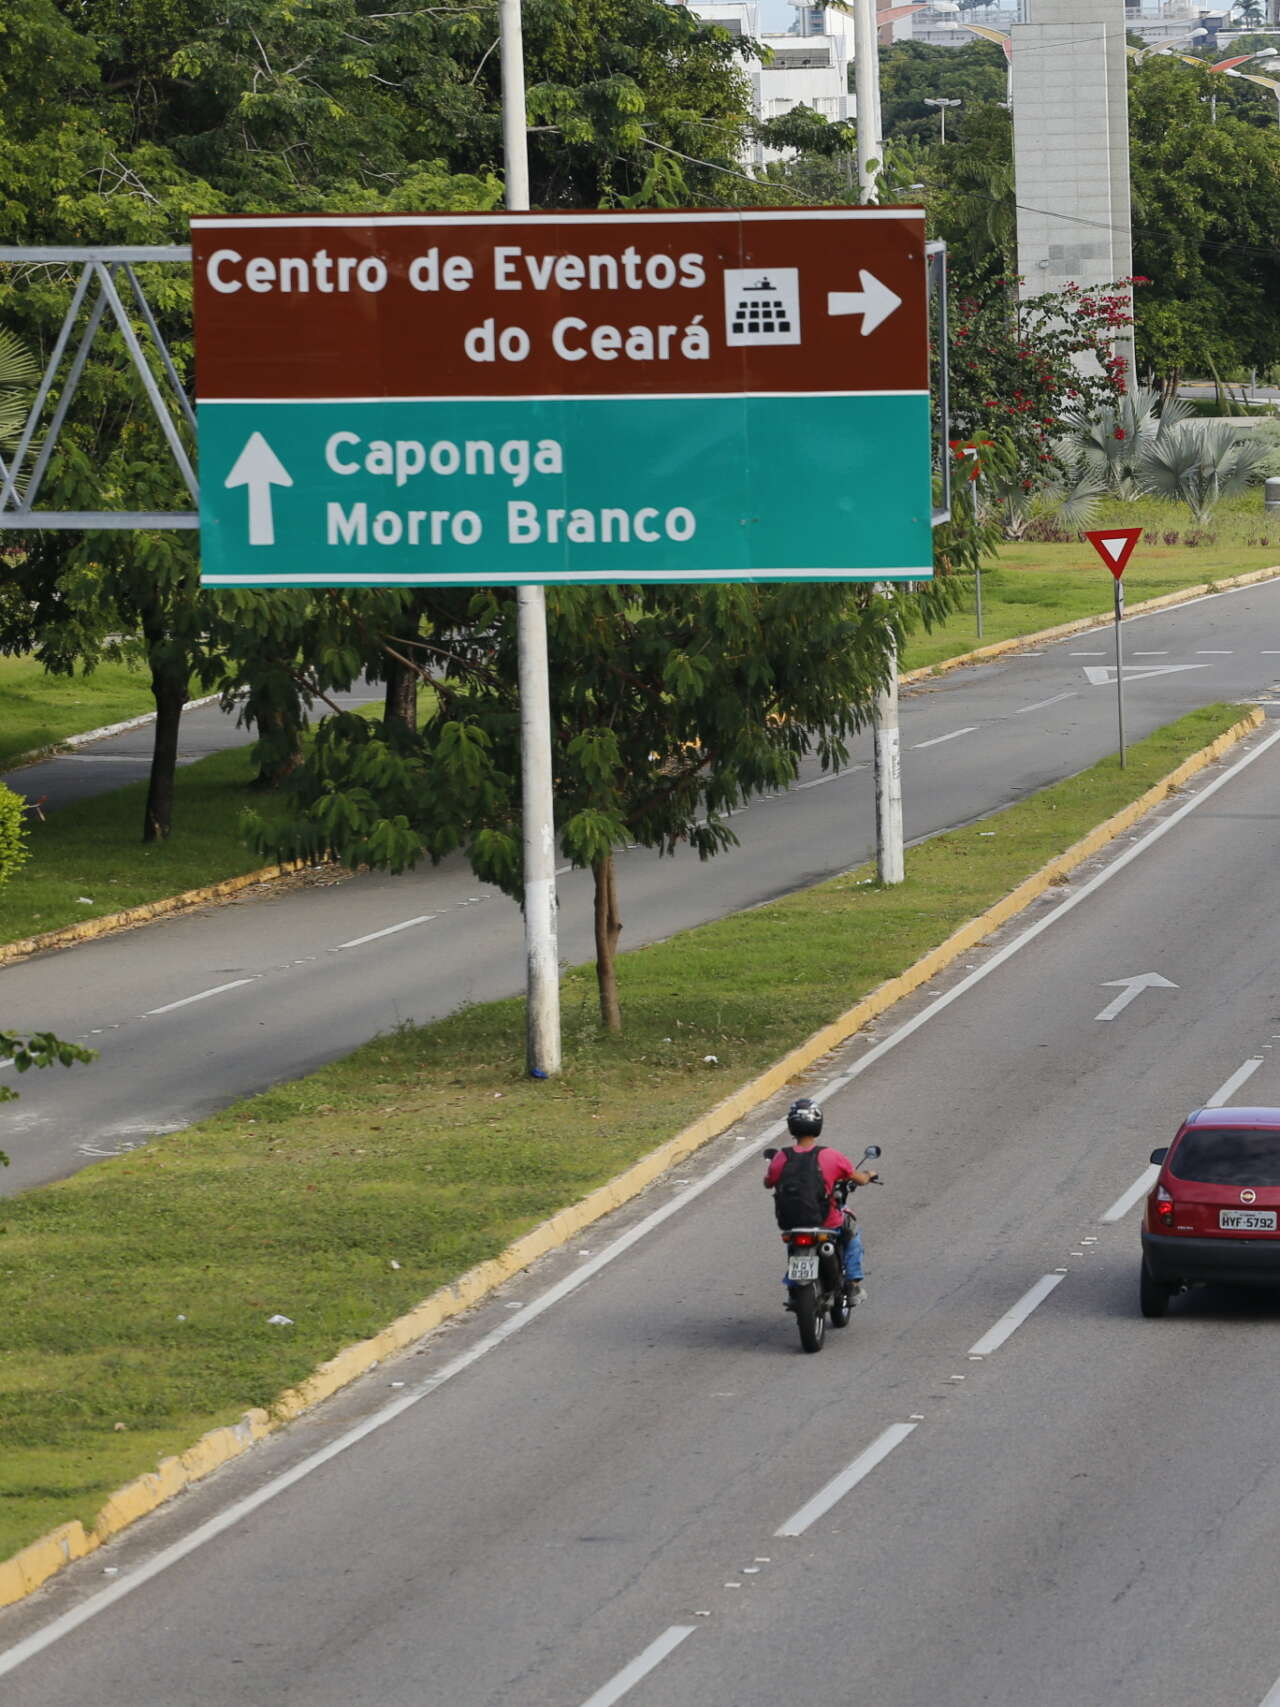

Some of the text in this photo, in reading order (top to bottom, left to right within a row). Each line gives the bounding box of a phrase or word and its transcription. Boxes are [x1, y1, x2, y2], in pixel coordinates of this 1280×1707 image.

[206, 245, 706, 295] Centro de Eventos
[464, 315, 710, 364] do Ceará
[325, 431, 563, 487] Caponga
[326, 500, 697, 547] Morro Branco
